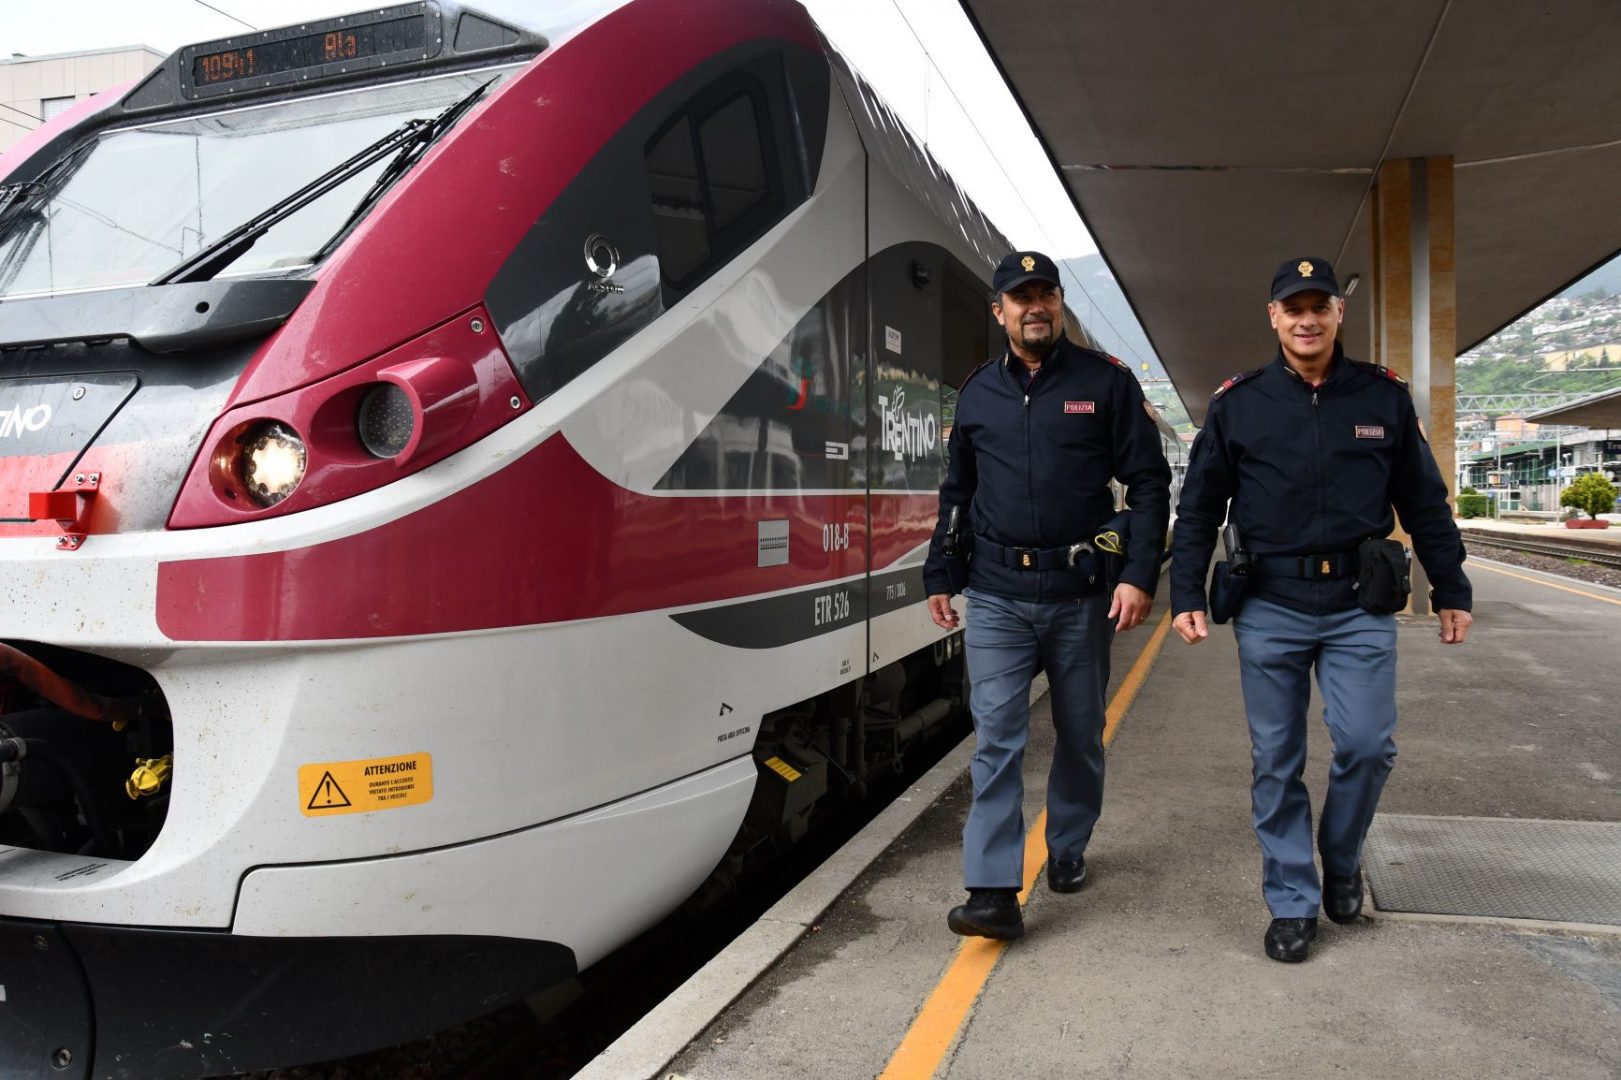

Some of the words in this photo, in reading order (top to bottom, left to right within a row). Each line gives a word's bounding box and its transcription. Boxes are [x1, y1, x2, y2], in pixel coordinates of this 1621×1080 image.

[202, 48, 255, 82] 10941
[1066, 403, 1093, 411] POLIZIA
[878, 394, 936, 463] TRENTINO
[814, 595, 832, 626] ETR
[834, 591, 850, 621] 526
[364, 760, 417, 776] ATTENZIONE
